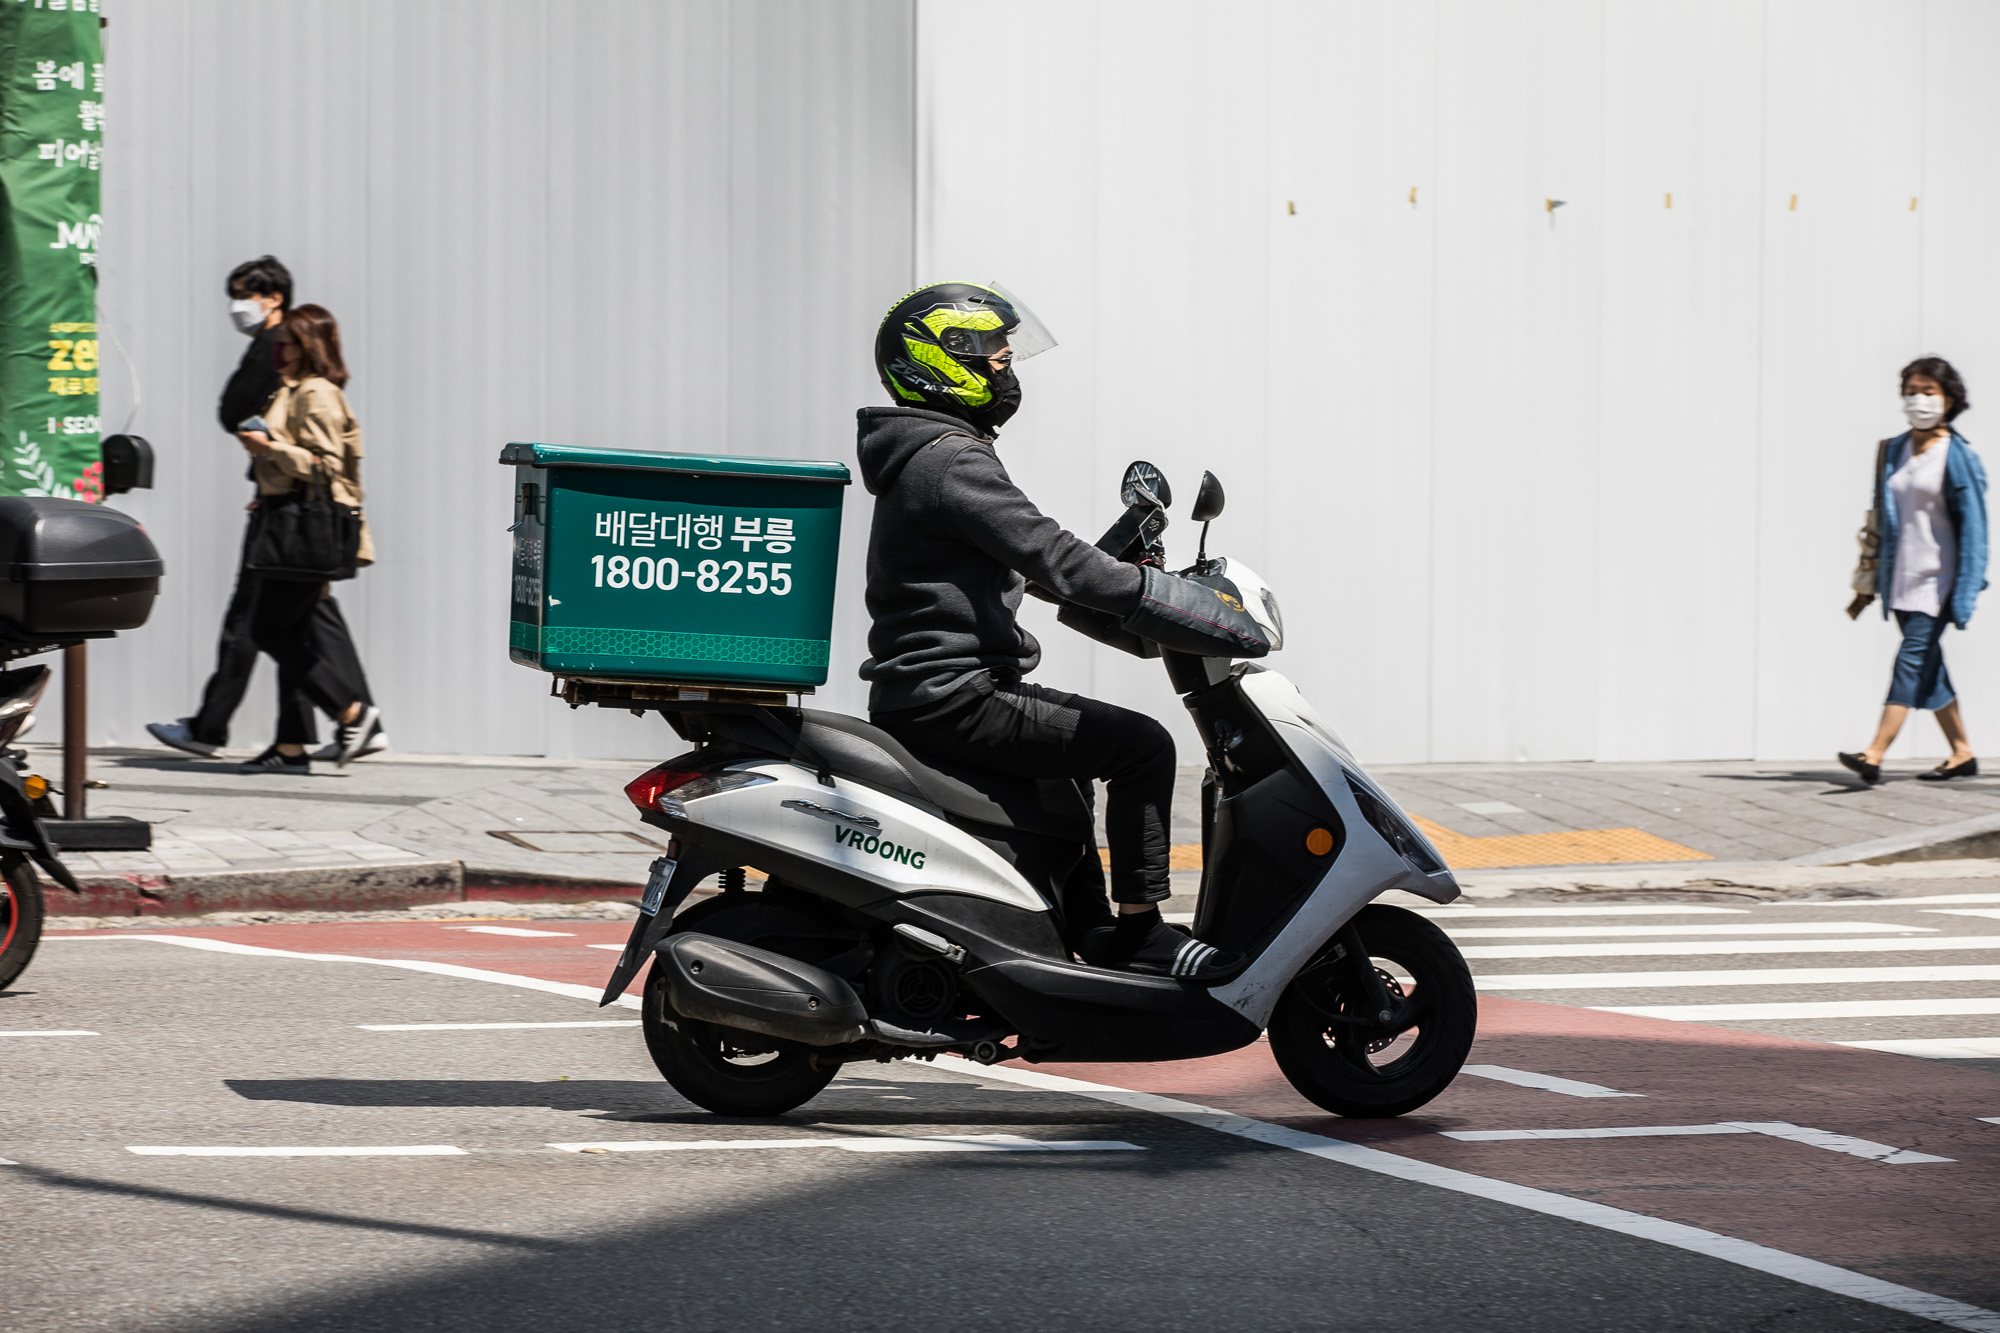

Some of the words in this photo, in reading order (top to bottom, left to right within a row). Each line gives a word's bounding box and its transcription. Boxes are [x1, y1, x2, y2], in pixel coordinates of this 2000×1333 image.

[31, 60, 85, 90] 봄에
[595, 511, 723, 550] 배달대행
[730, 516, 797, 554] 부릉
[591, 555, 792, 596] 1800-8255
[834, 824, 926, 870] VROONG
